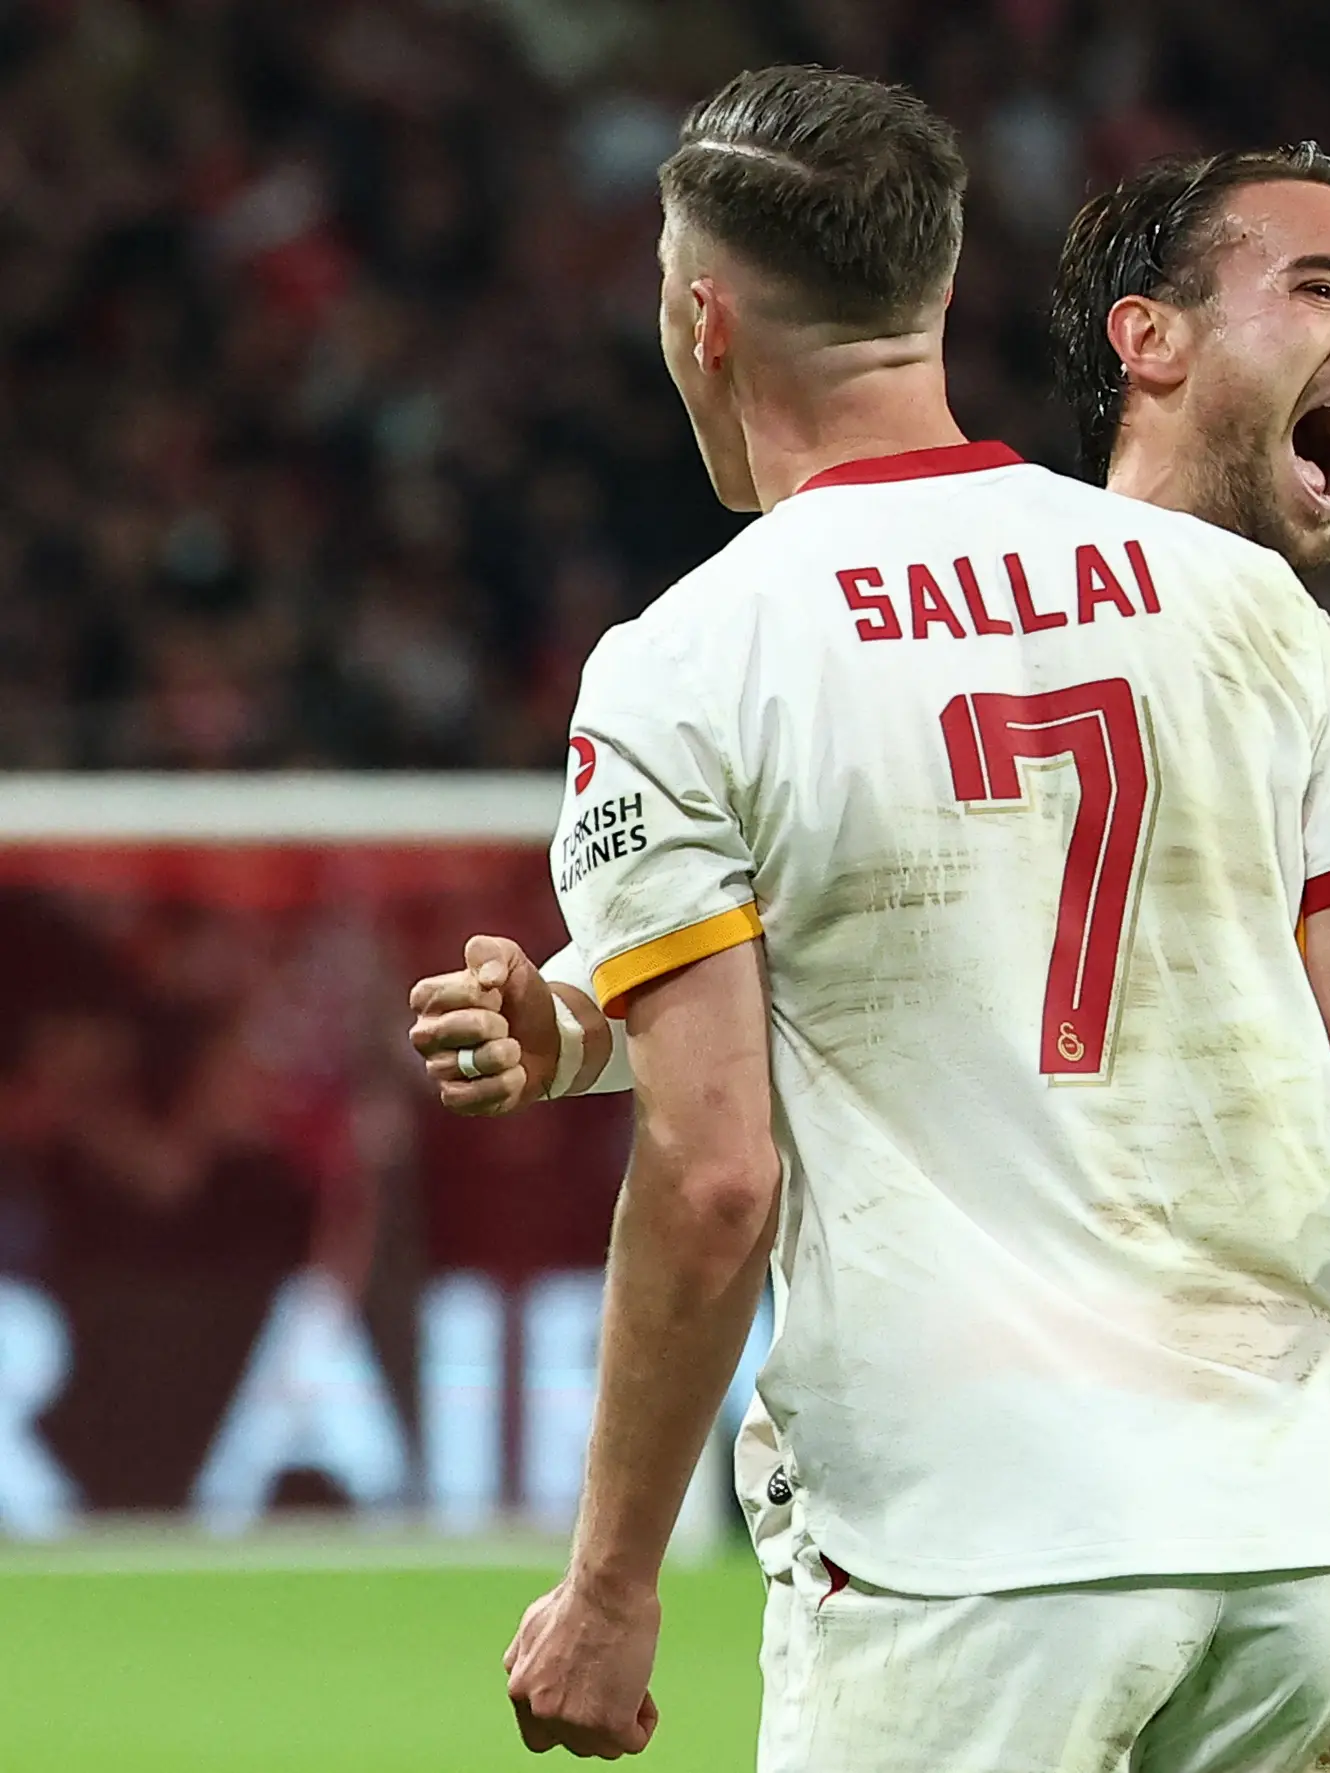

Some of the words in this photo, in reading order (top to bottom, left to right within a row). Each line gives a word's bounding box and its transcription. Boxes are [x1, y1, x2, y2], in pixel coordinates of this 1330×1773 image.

[835, 540, 1162, 642] SALLAI
[560, 824, 648, 893] AIRLINES
[563, 792, 642, 864] TURKISH
[939, 677, 1152, 1076] 7
